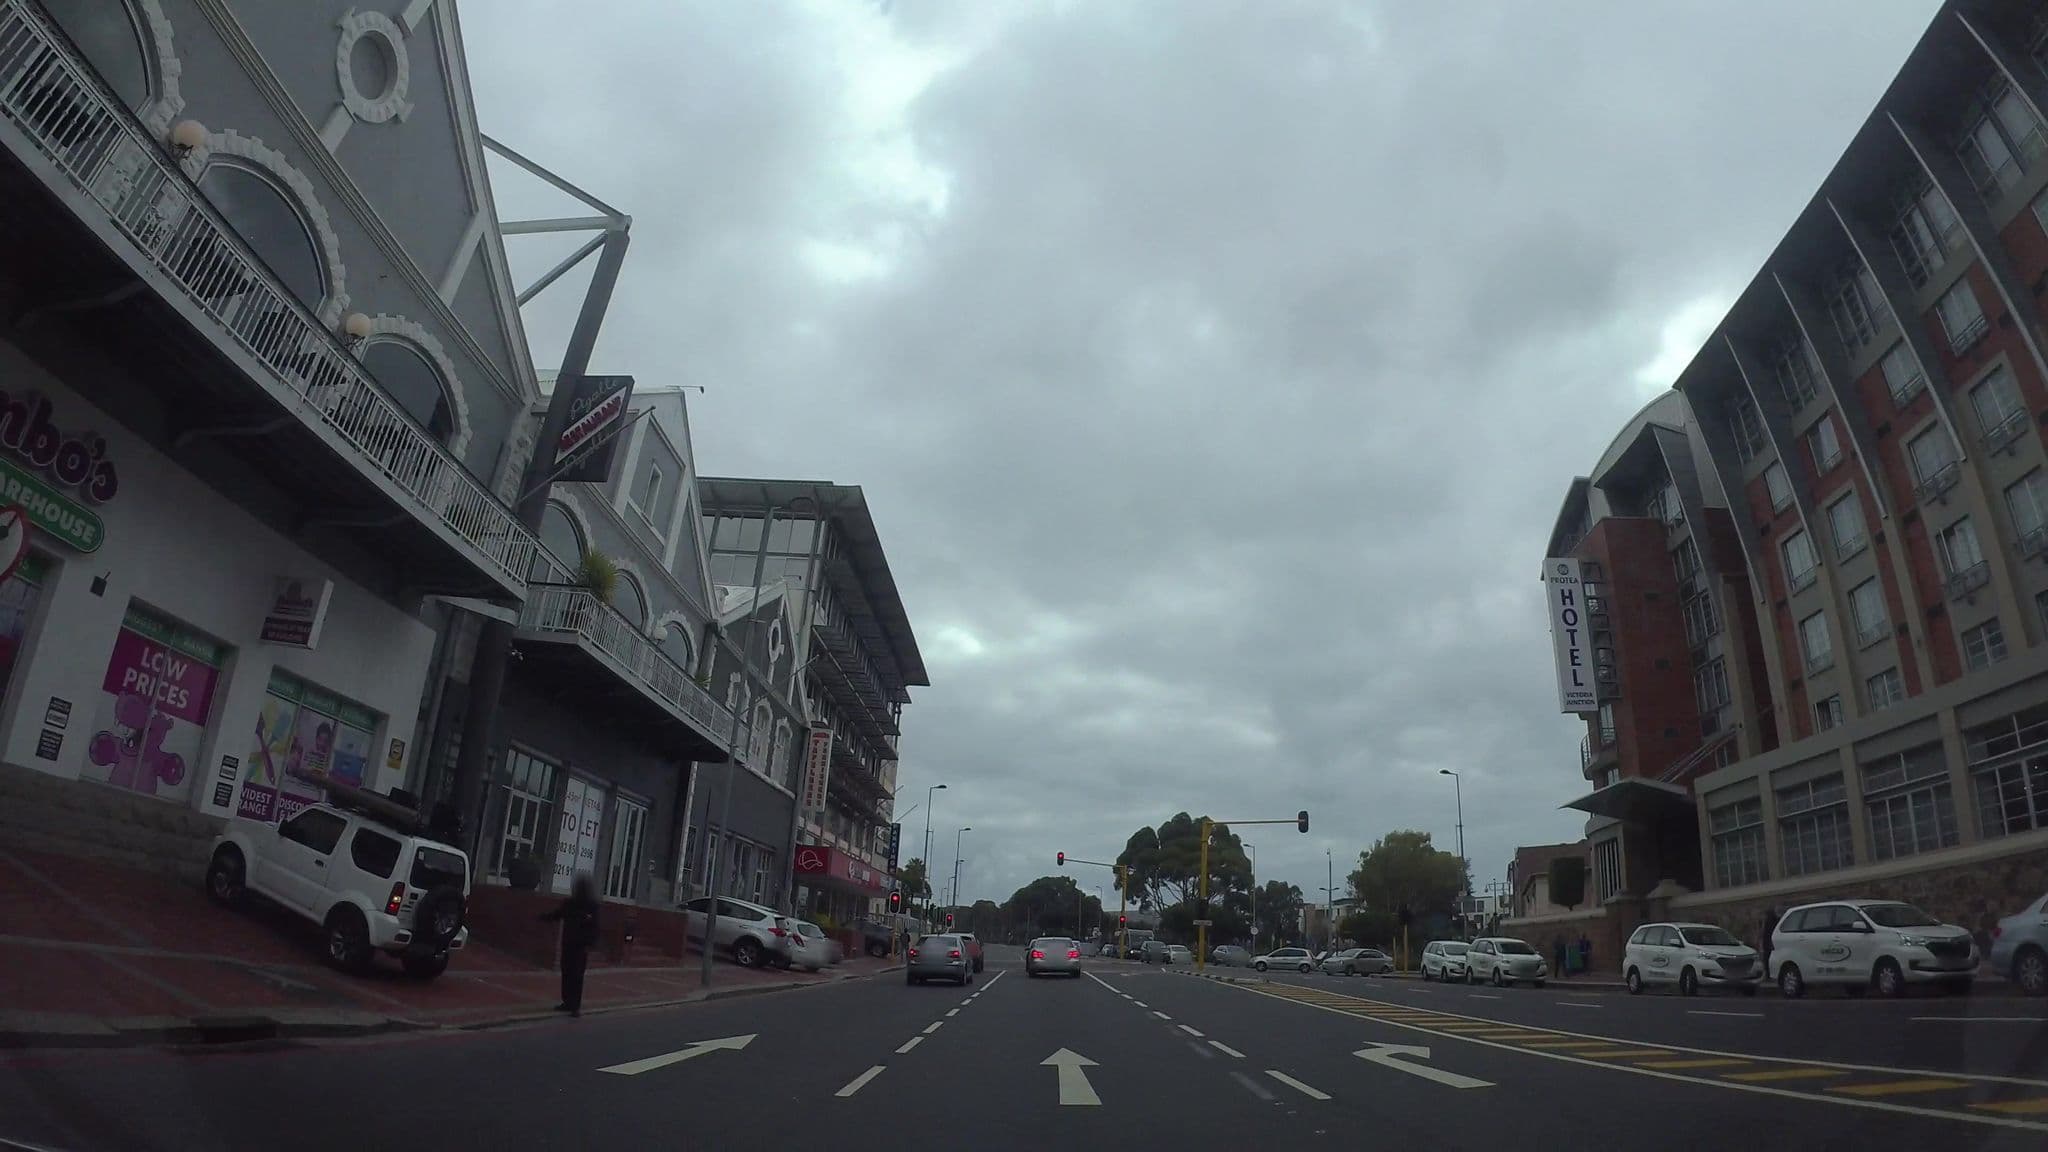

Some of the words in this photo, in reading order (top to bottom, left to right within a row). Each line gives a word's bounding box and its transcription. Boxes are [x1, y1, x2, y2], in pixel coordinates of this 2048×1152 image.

[1560, 589, 1583, 687] HOTEL
[141, 647, 188, 681] LOW
[122, 667, 190, 709] PRICES
[562, 811, 577, 831] TO
